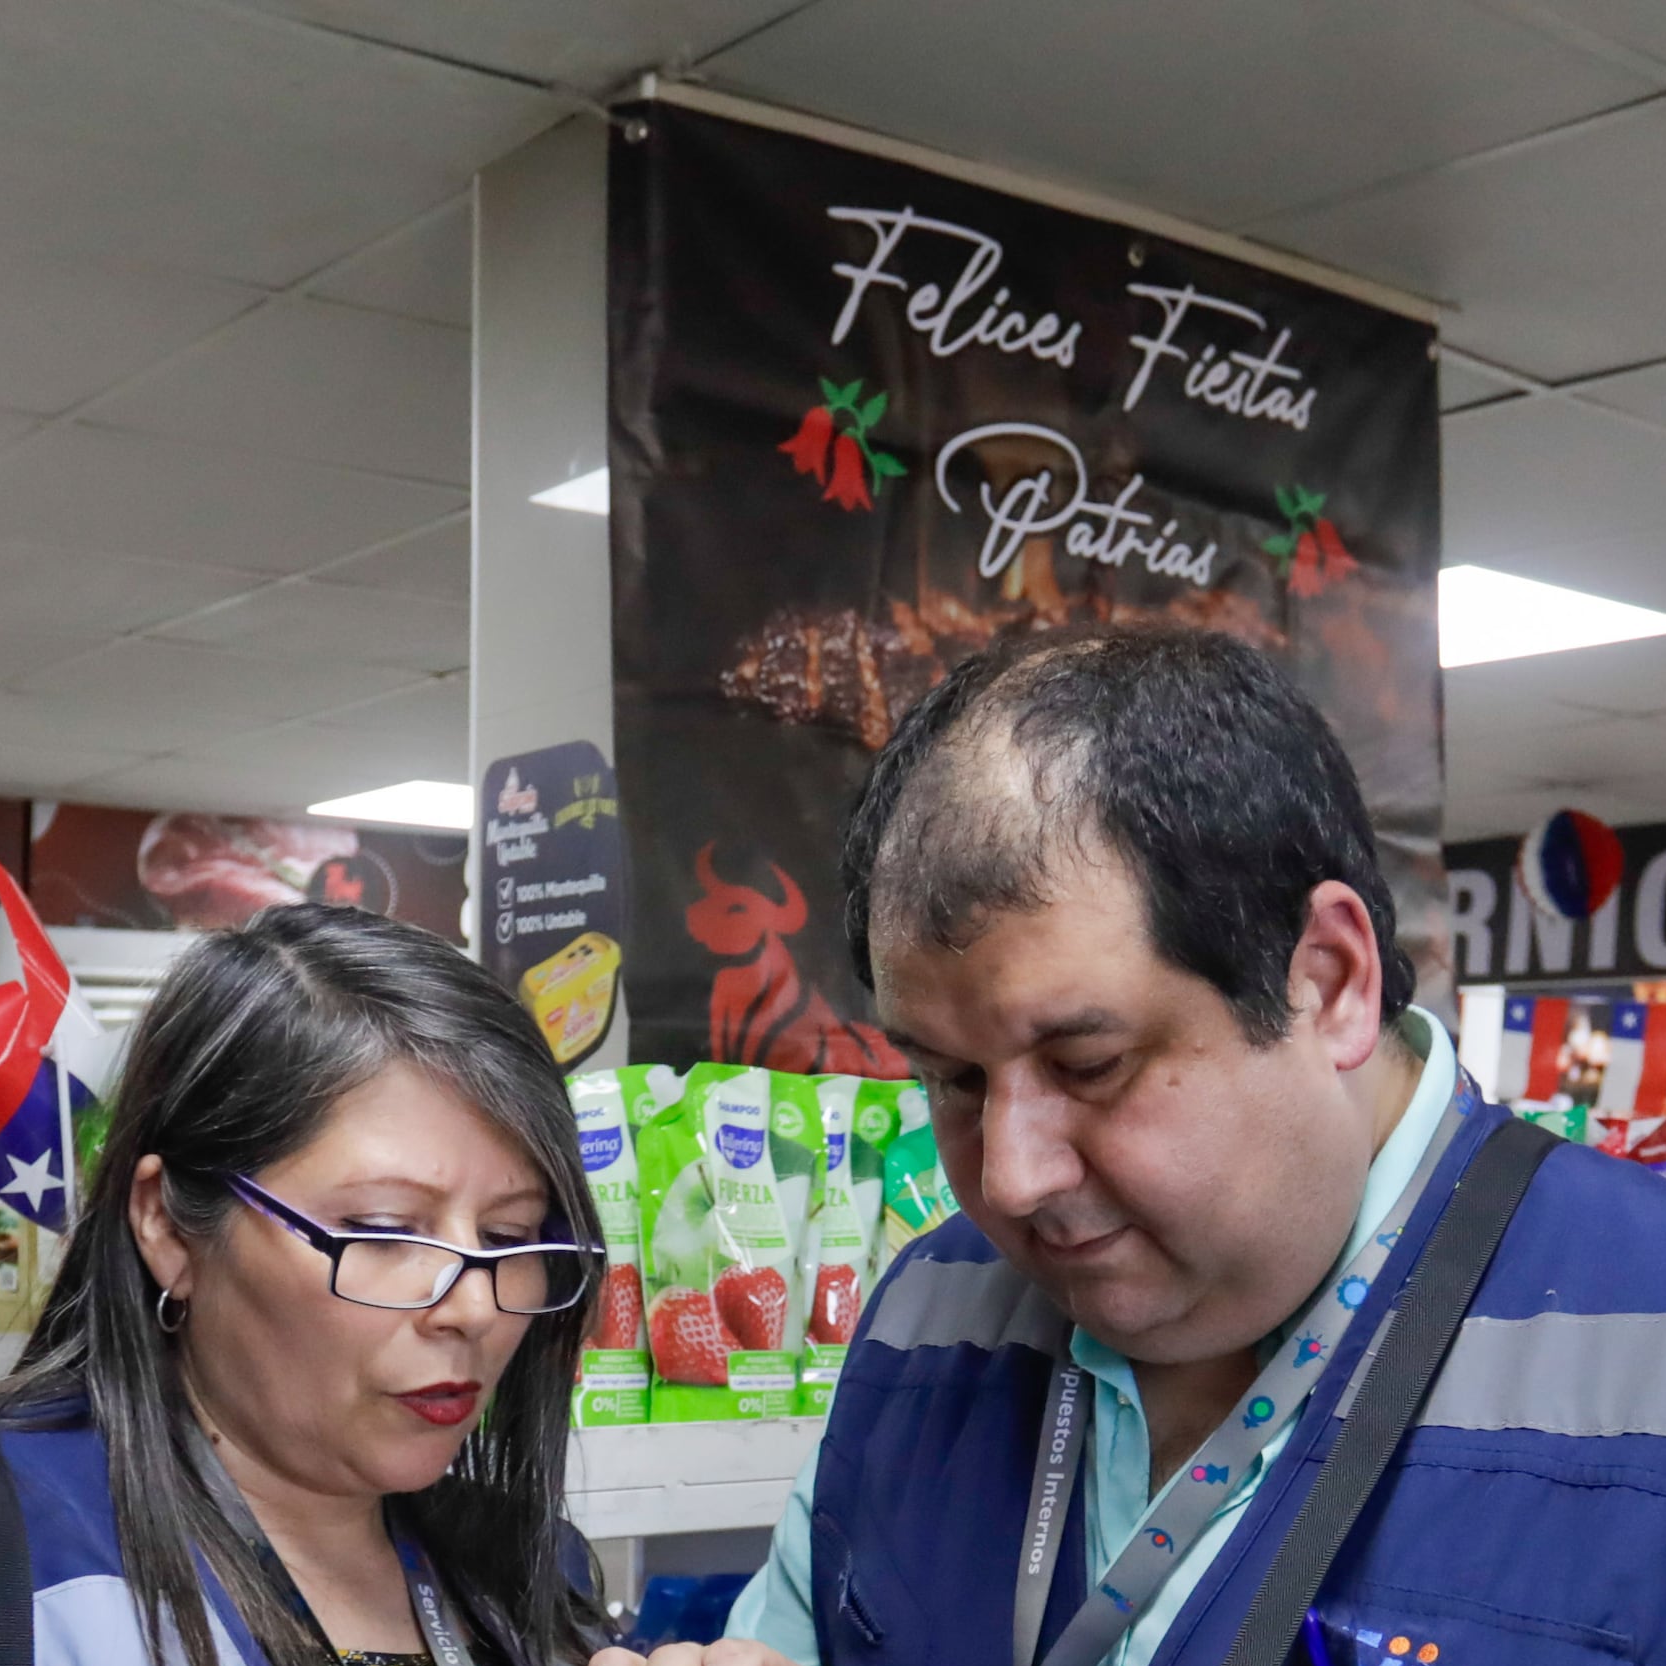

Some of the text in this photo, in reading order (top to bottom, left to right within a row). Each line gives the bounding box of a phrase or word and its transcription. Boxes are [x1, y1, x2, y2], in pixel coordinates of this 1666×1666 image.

[825, 203, 1316, 433] Felices Fiestas
[936, 421, 1217, 586] Patrias
[580, 1136, 620, 1155] erina
[1027, 1361, 1082, 1576] puestos Internos
[417, 1583, 460, 1665] Servicio
